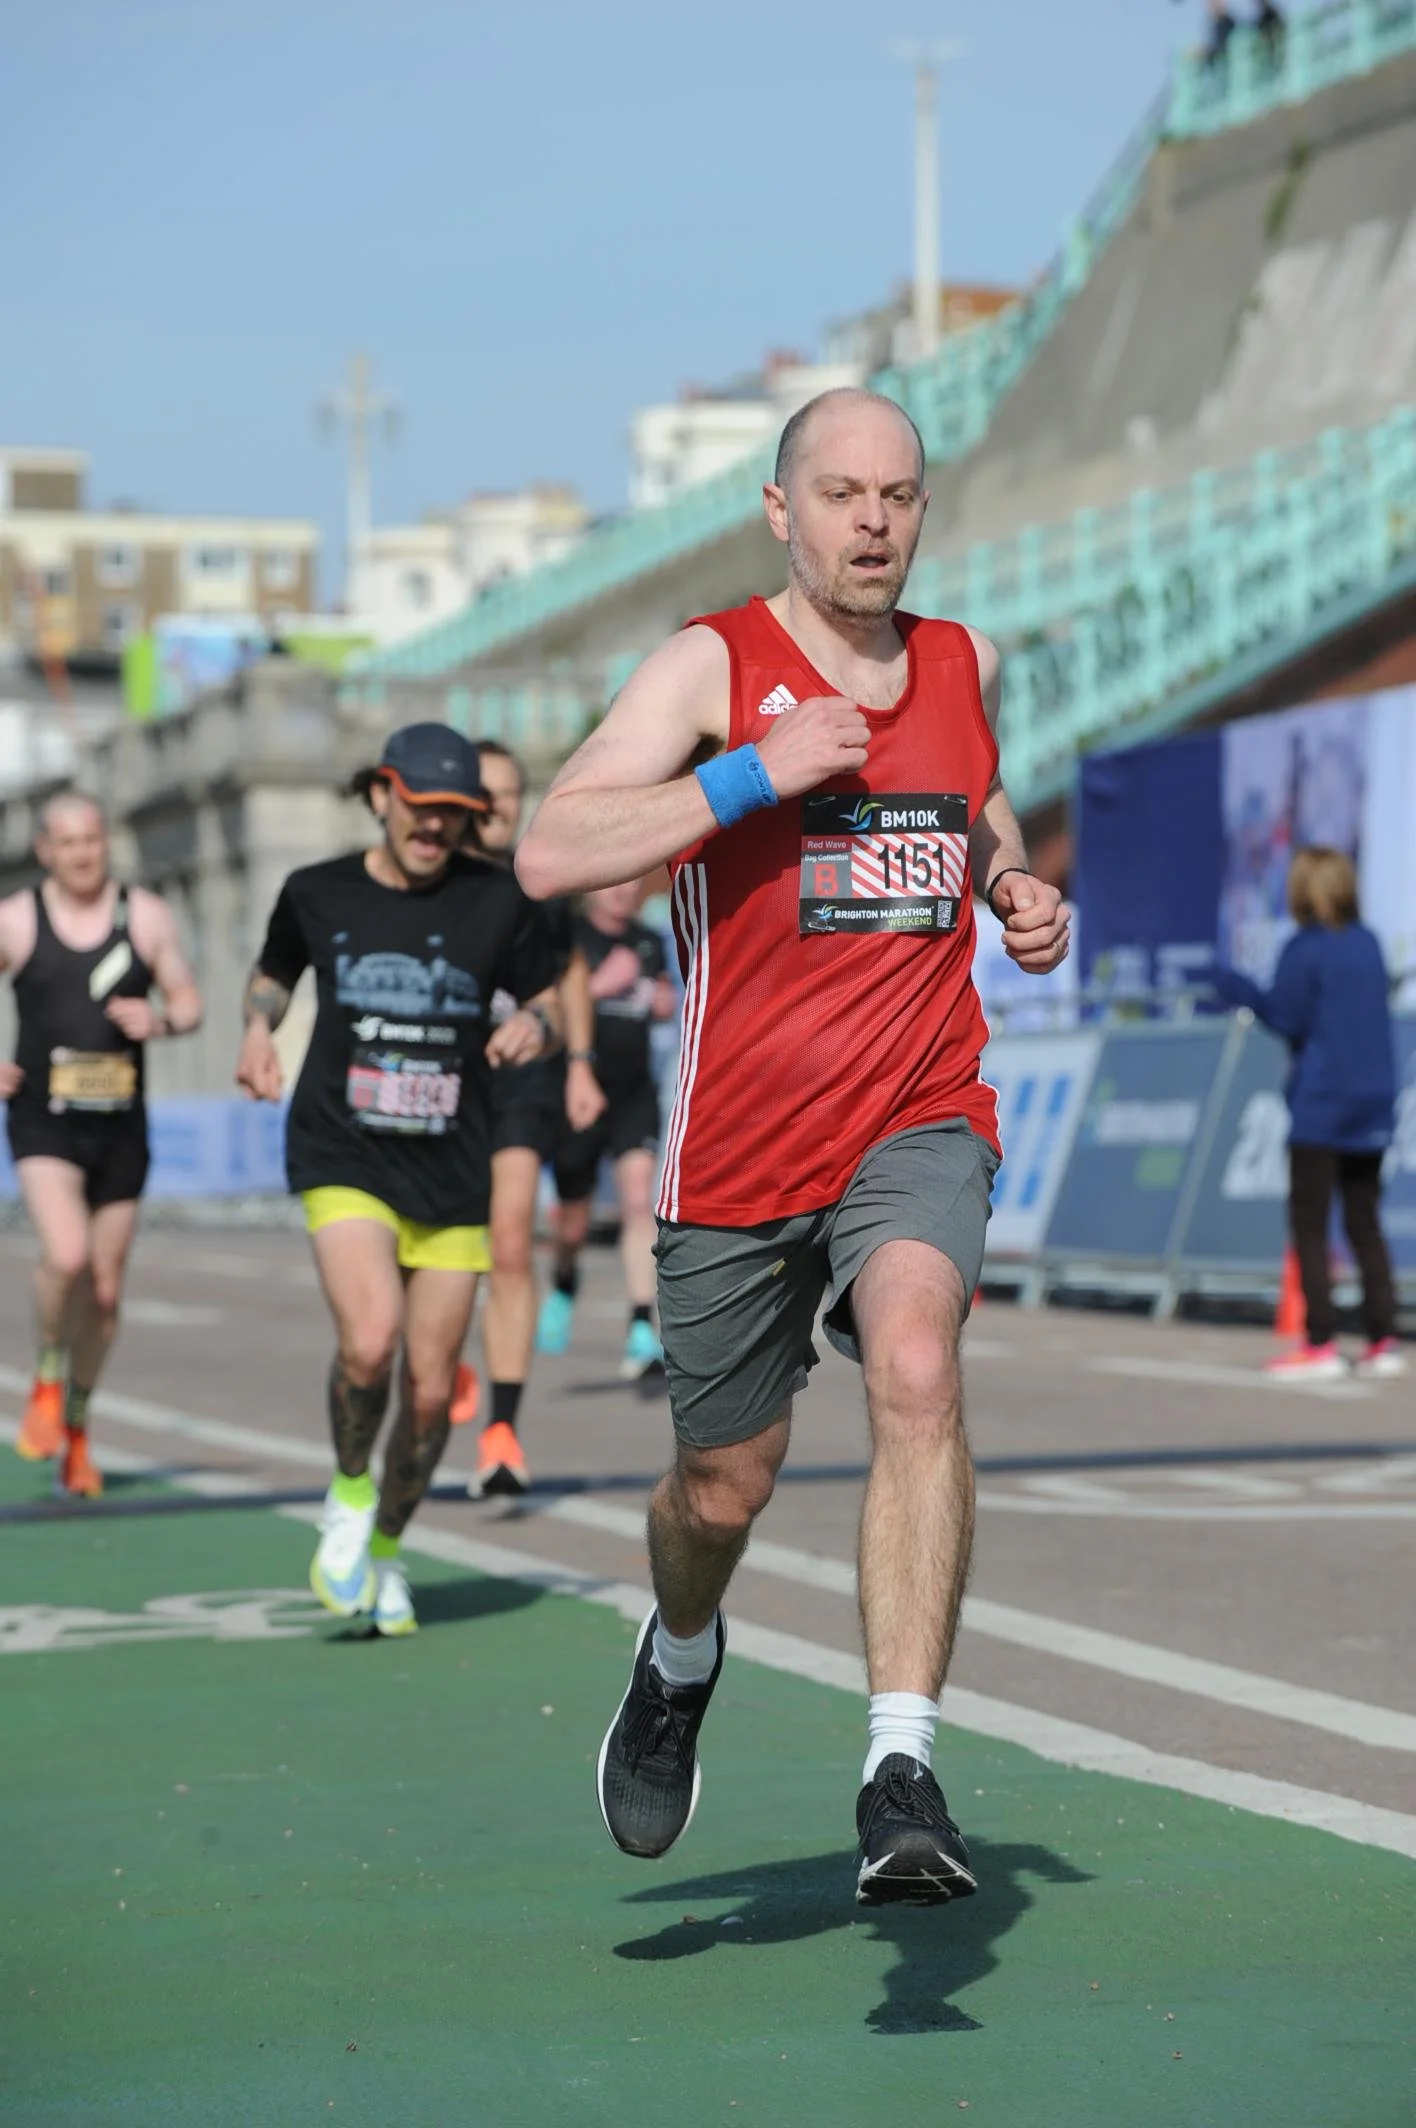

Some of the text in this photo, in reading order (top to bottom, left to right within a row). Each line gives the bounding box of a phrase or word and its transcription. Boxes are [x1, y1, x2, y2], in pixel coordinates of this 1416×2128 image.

[881, 810, 940, 828] BM10K
[807, 840, 847, 849] Red Wave
[804, 854, 849, 862] Bag Collection
[878, 842, 945, 889] 1151
[814, 864, 839, 897] B
[834, 908, 932, 919] BRIGHTON MARATHON
[888, 917, 932, 927] WEEKEND
